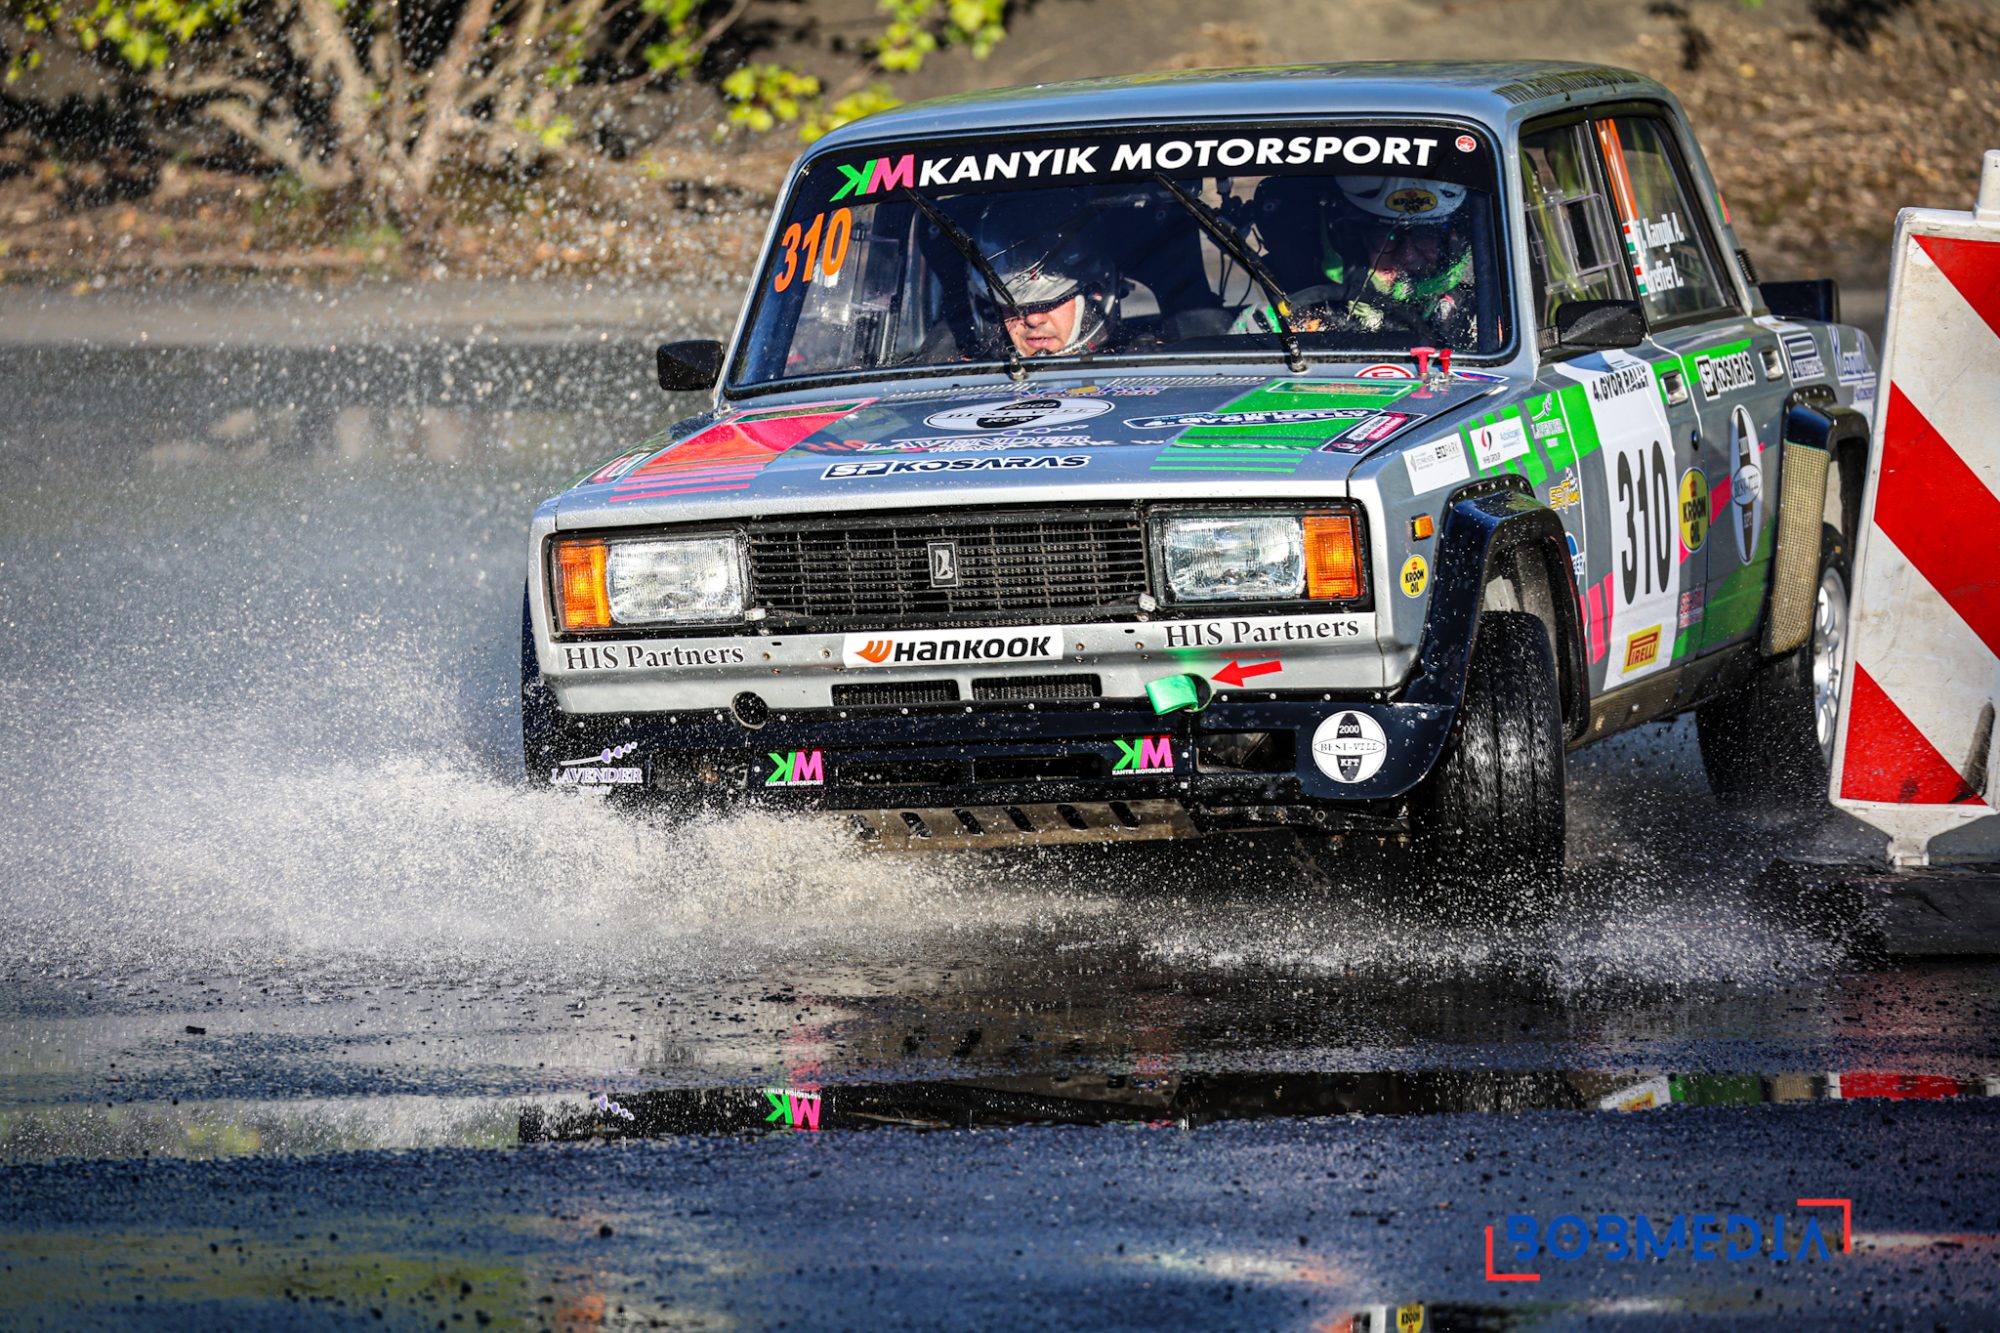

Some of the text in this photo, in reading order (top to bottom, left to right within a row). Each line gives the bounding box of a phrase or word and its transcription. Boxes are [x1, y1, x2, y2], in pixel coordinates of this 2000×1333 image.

[829, 155, 914, 202] KM
[919, 145, 1097, 187] KANYIK
[1110, 135, 1438, 172] MOTORSPORT
[774, 207, 852, 293] 310
[1002, 402, 1058, 411] 2000
[826, 456, 1090, 478] SP KOSARAS
[1617, 440, 1671, 605] 310
[1682, 496, 1707, 523] KROON
[1690, 522, 1701, 543] OIL
[1405, 570, 1425, 584] KROON
[1410, 581, 1421, 593] OIL
[1164, 618, 1360, 648] HIS Partners
[565, 644, 744, 670] HIS Partners
[1626, 631, 1659, 667] PIRELLI
[1338, 725, 1360, 735] 2000
[1112, 735, 1174, 769] KM
[1341, 758, 1360, 768] KFT
[550, 768, 643, 784] LAVENDER
[766, 750, 824, 782] KM
